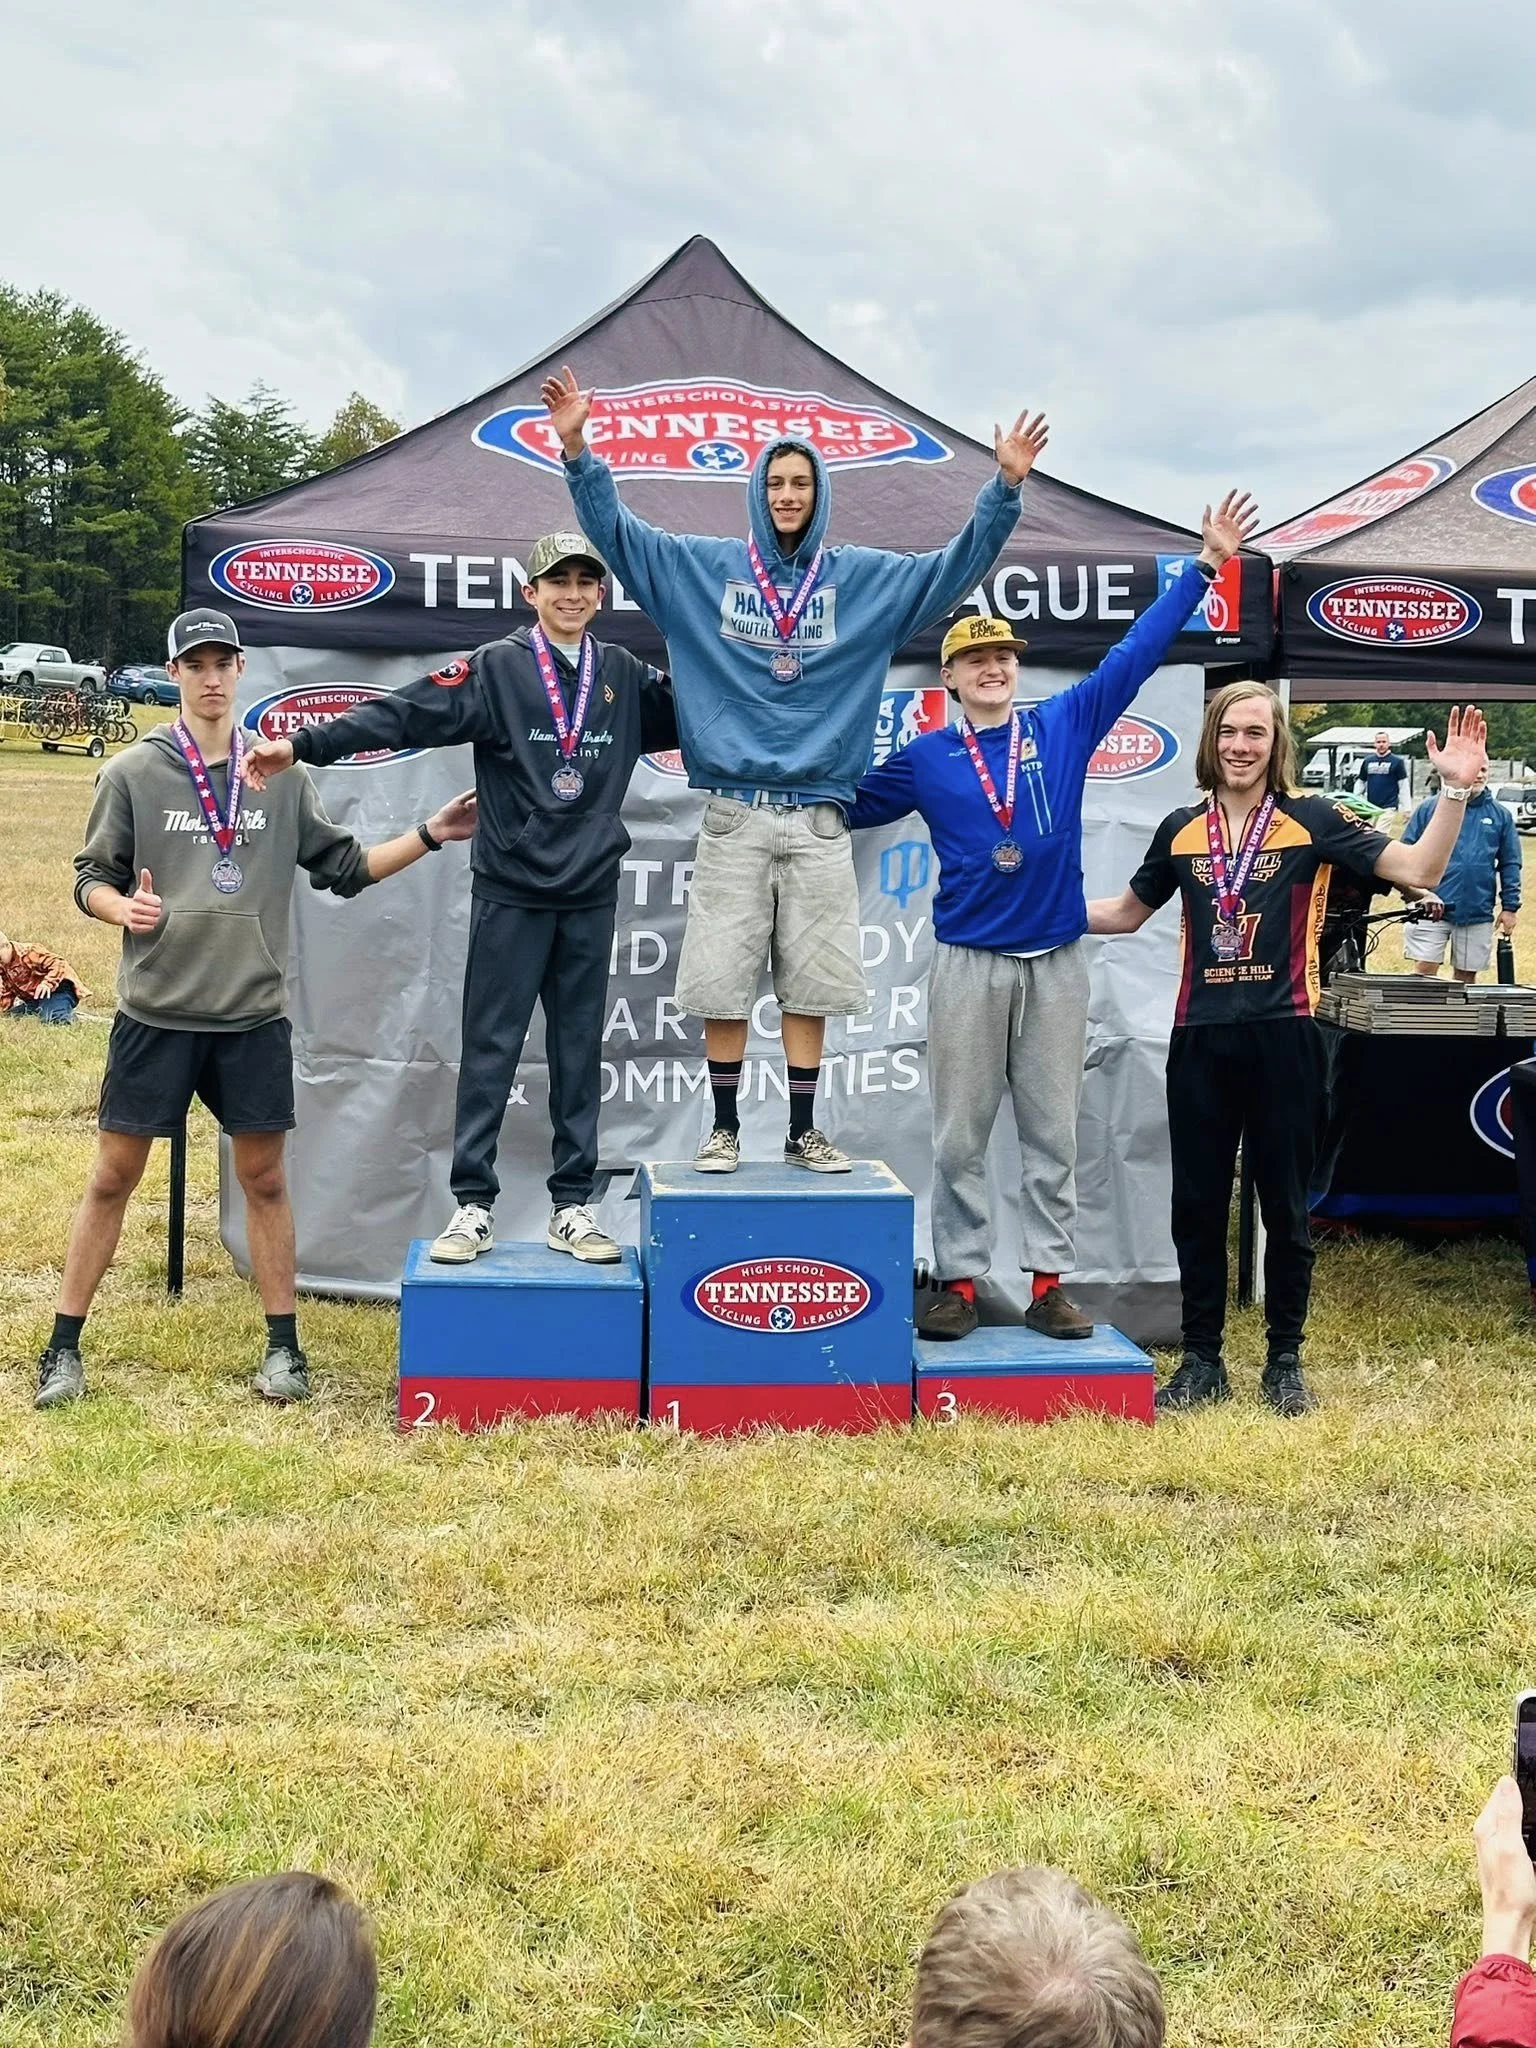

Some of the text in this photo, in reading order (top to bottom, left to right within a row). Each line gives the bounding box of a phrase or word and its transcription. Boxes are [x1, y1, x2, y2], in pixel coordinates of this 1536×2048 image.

[603, 391, 819, 414] INTERSCHOLASTIC
[260, 547, 345, 560] INTERSCHOLASTIC
[232, 561, 371, 583] TENNESSEE
[239, 580, 363, 600] CYCLING LEAGUE
[1354, 584, 1435, 599] INTERSCHOLASTIC
[1328, 598, 1461, 620] TENNESSEE
[731, 618, 768, 638] YOUTH
[969, 619, 988, 631] DIRT
[1335, 616, 1452, 638] CYCLING LEAGUE
[555, 716, 569, 740] 2025
[582, 730, 614, 744] Brady
[873, 697, 895, 766] NICA
[1021, 761, 1043, 773] MTB
[1095, 755, 1145, 772] LEAGUE
[208, 811, 223, 832] 2025
[1230, 845, 1256, 896] TENNESSEE
[1250, 964, 1275, 975] HILL
[741, 1263, 826, 1279] HIGH SCHOOL
[704, 1281, 861, 1304] TENNESSEE
[711, 1303, 851, 1326] CYCLING LEAGUE
[413, 1391, 438, 1428] 2
[666, 1400, 682, 1430] 1
[936, 1391, 958, 1423] 3
